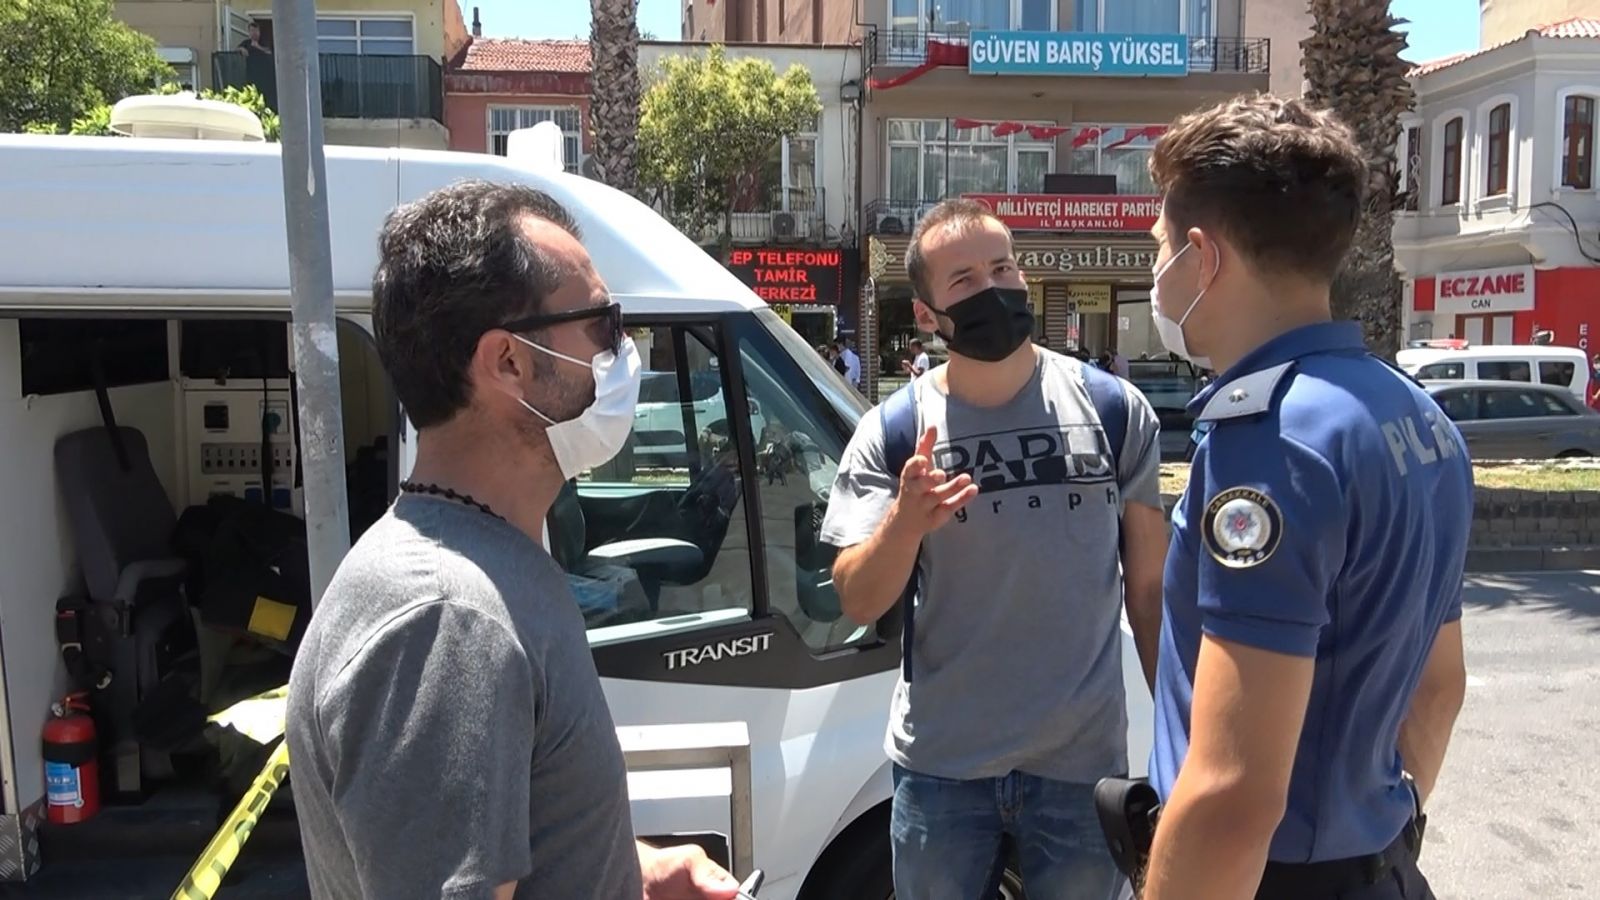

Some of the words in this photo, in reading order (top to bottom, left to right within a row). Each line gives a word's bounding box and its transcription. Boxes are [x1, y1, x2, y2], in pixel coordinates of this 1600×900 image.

[972, 34, 1040, 65] GÜVEN
[1046, 40, 1104, 71] BARIŞ
[1110, 36, 1184, 67] YÜKSEL
[996, 198, 1061, 220] MİLLİYETÇİ
[1065, 202, 1118, 217] HAREKET
[1121, 199, 1162, 217] PARTİS
[757, 252, 839, 266] TELEFONU
[754, 268, 807, 282] TAMİR
[1440, 273, 1525, 298] ECZANE
[1471, 299, 1491, 308] CAN
[663, 632, 774, 670] TRANSIT
